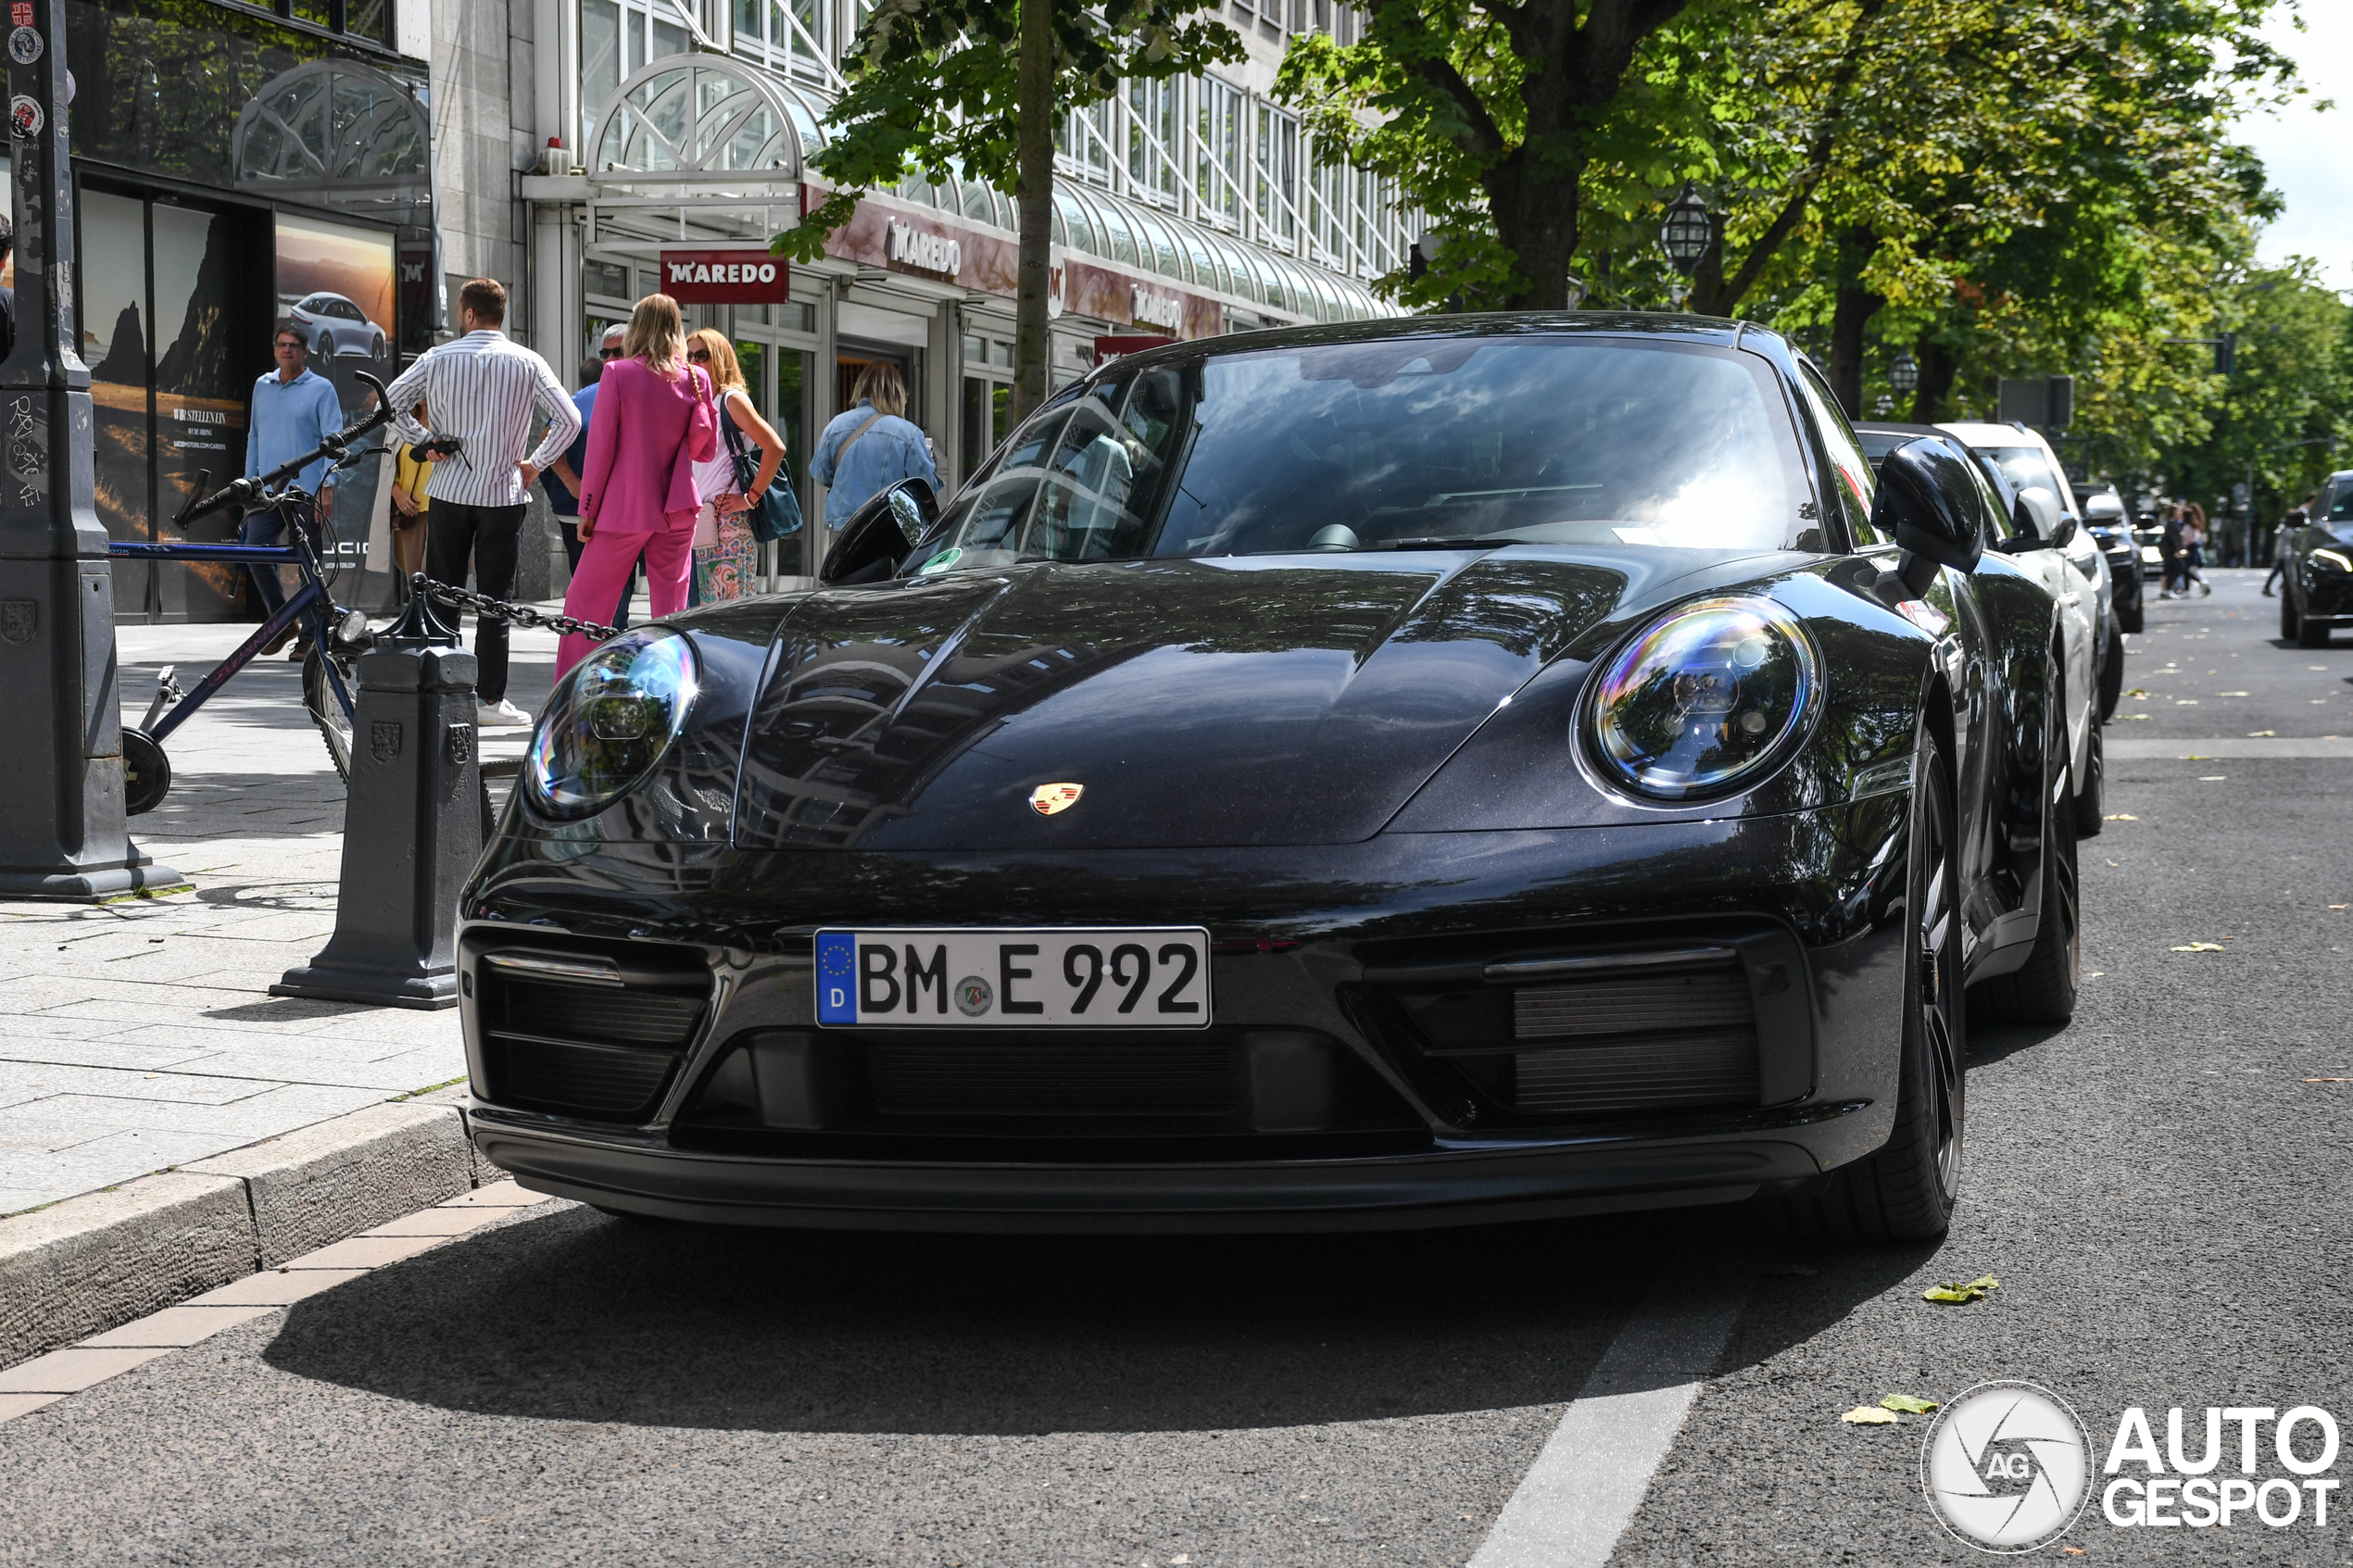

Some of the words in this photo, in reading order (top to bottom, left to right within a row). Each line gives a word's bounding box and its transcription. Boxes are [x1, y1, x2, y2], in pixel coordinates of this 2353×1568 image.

[888, 216, 961, 276] MAREDO
[667, 260, 776, 283] MAREDO
[1130, 283, 1182, 331] MAREDO
[173, 408, 186, 420] WIR
[187, 410, 215, 423] STELLEN
[215, 412, 226, 424] EIN
[322, 542, 369, 554] UCI
[208, 613, 278, 686] GIANT
[860, 944, 948, 1014] BM
[1000, 944, 1044, 1014] E
[1063, 943, 1199, 1014] 992
[831, 988, 845, 1008] D
